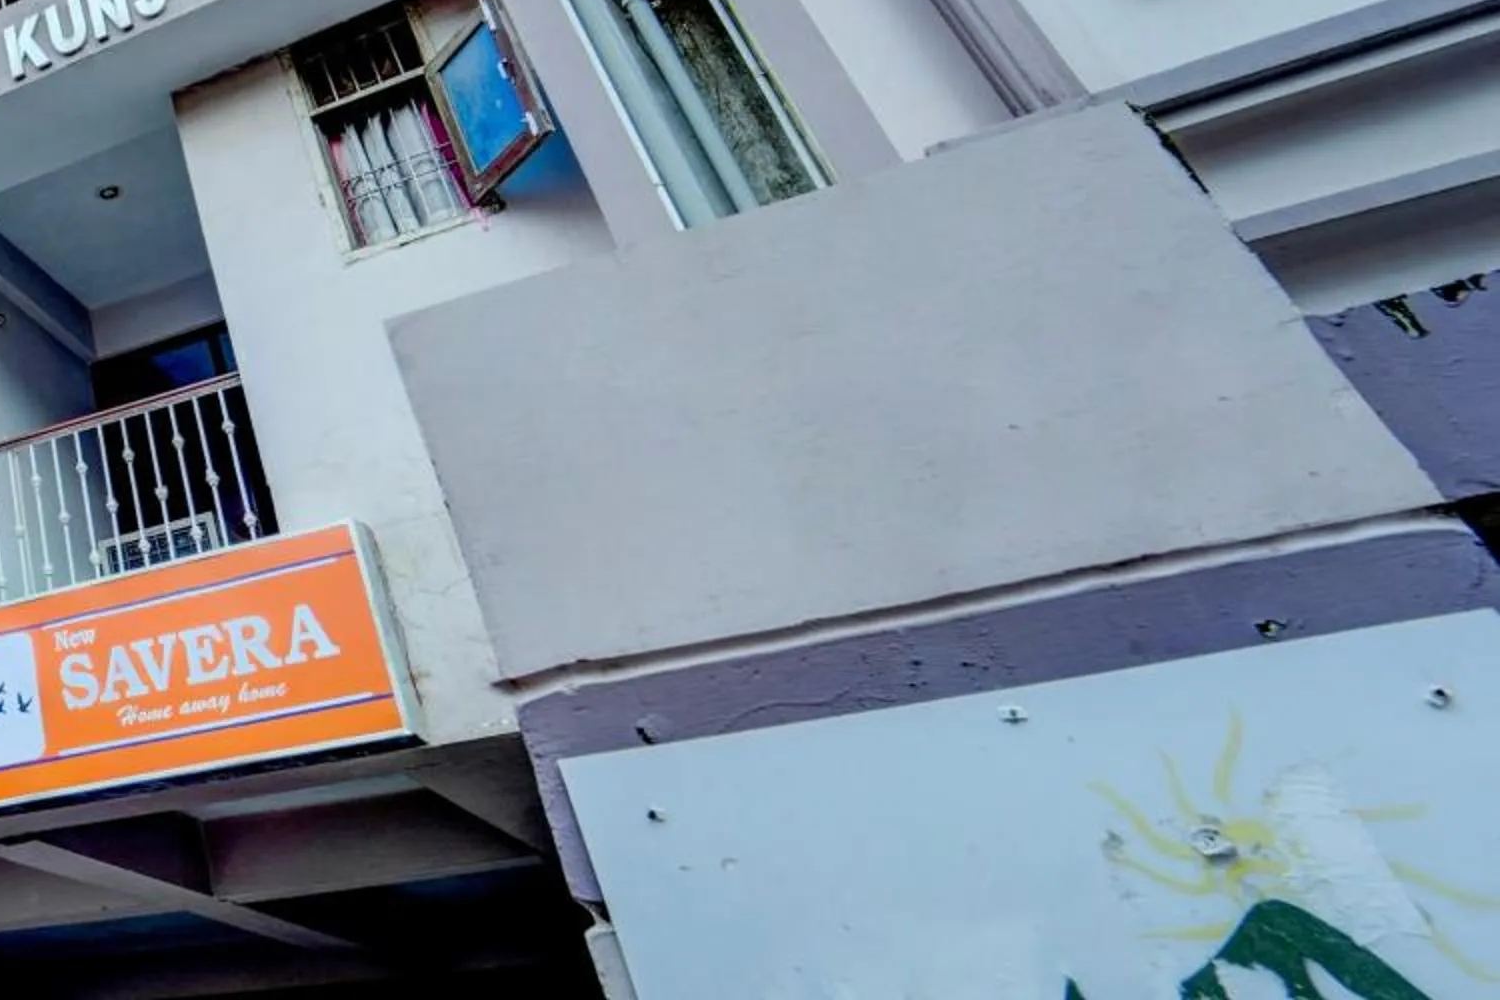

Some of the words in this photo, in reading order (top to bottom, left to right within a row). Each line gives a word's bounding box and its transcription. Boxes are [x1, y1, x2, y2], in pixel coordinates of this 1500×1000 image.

[53, 628, 96, 651] New
[59, 603, 341, 710] SAVERA
[116, 703, 174, 727] Home
[179, 694, 230, 716] away
[238, 681, 288, 703] home
